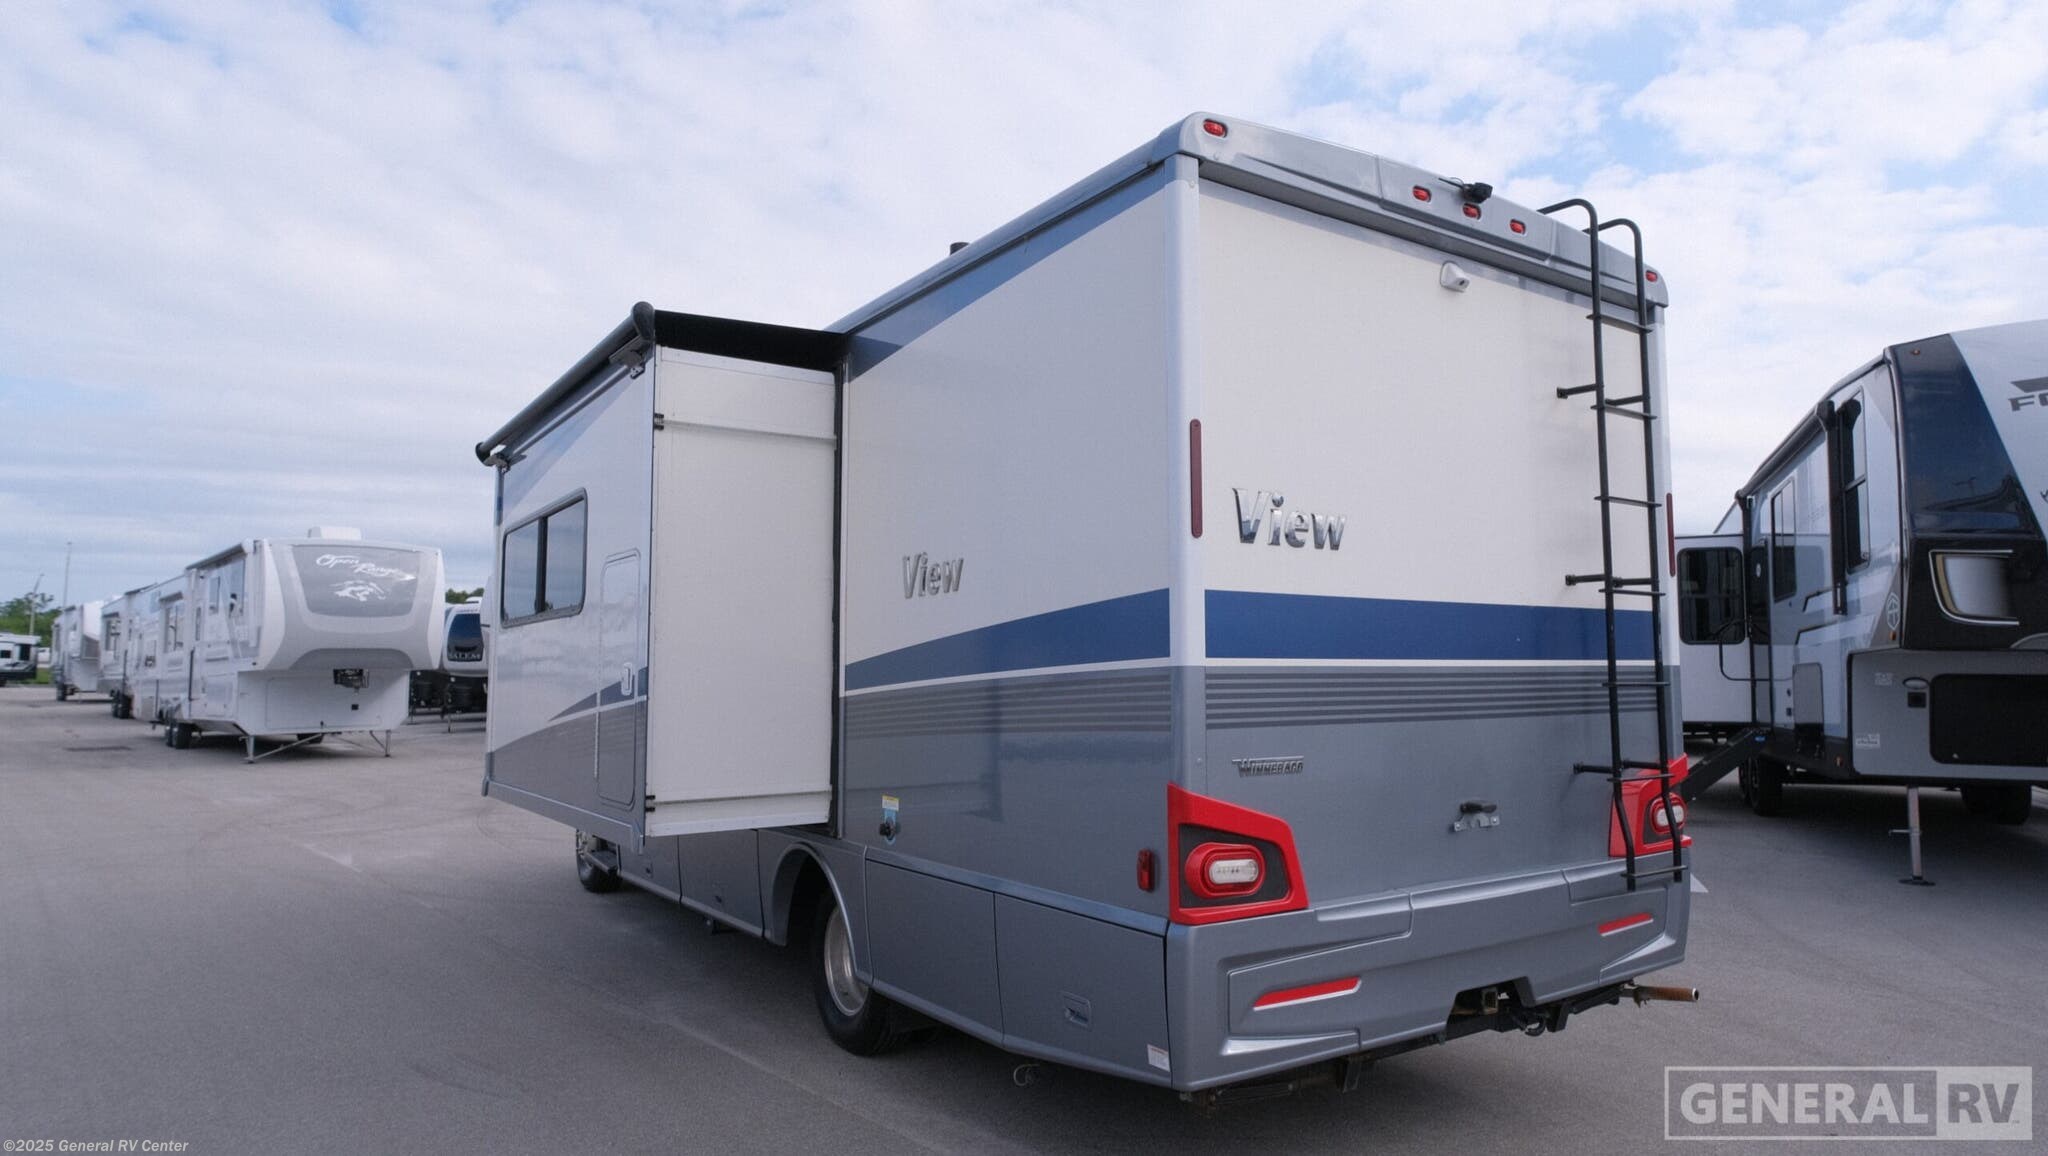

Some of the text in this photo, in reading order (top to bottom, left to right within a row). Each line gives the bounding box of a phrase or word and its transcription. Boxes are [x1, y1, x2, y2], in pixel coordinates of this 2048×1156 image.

[1231, 487, 1348, 551] View
[316, 554, 359, 569] Open
[902, 551, 965, 599] View
